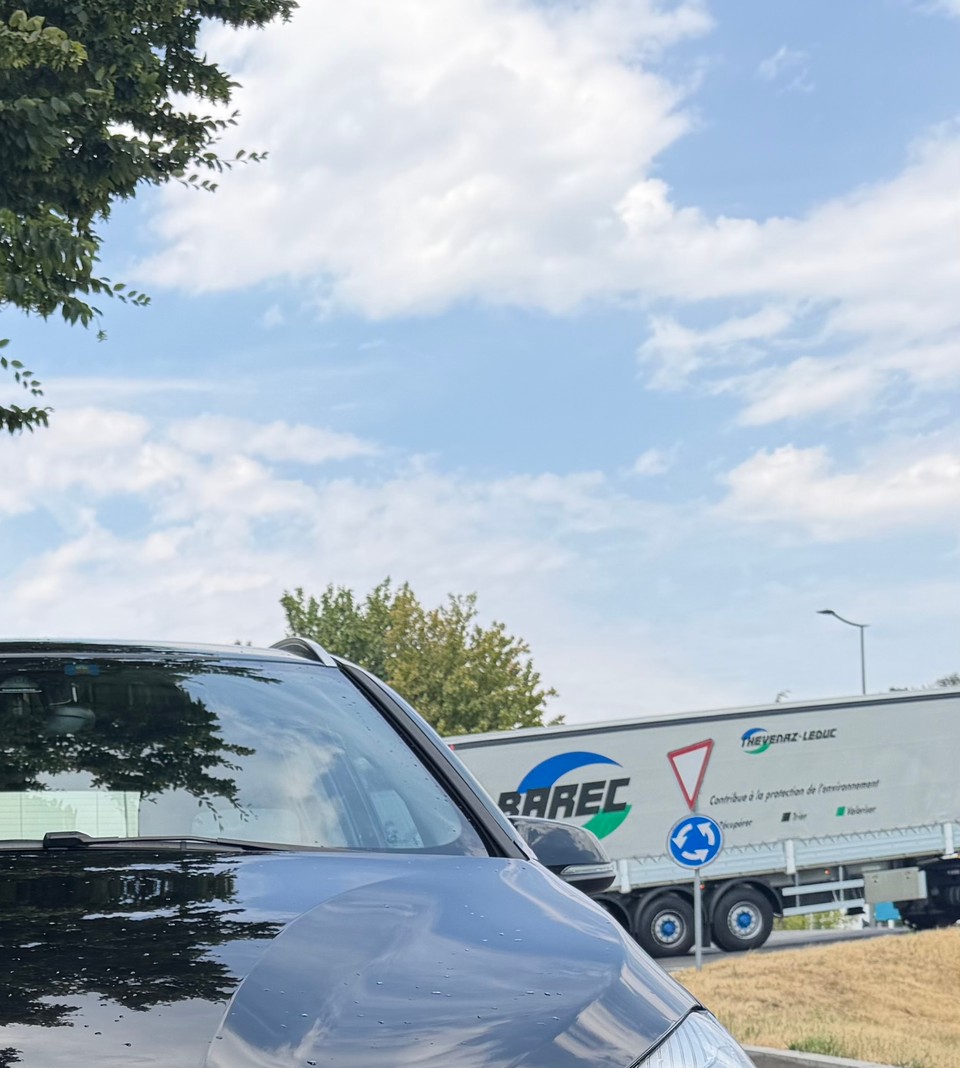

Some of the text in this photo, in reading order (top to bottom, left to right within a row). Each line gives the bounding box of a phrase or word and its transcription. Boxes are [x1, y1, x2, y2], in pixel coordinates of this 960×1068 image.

[709, 791, 747, 805] Contribue
[755, 789, 764, 801] la
[765, 785, 805, 803] protection
[806, 784, 816, 796] de
[817, 779, 880, 795] l'environnement
